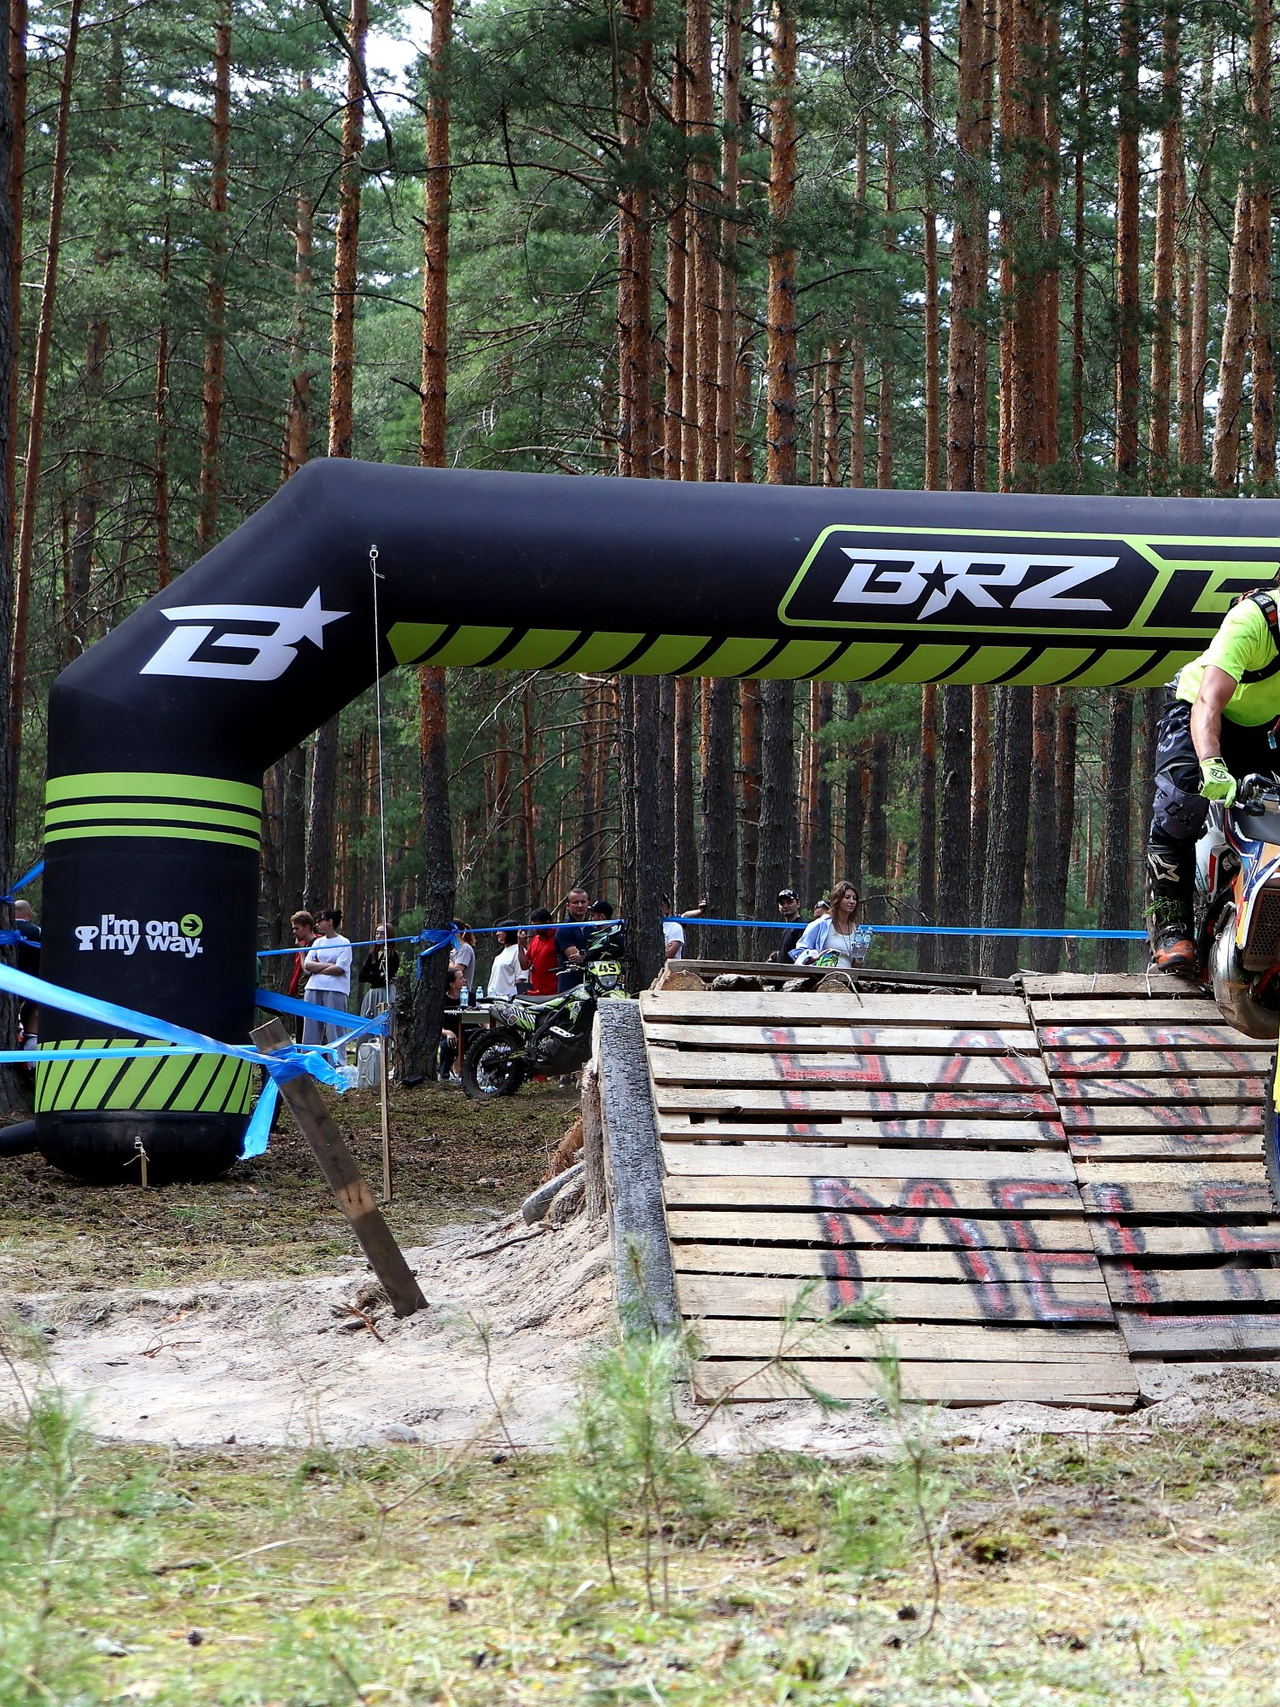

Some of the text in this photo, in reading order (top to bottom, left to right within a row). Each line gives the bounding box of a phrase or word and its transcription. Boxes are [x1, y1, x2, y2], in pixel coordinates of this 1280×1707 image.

[832, 547, 1120, 620] BRZ
[101, 914, 179, 937] I'm on
[100, 934, 203, 958] my way.
[599, 963, 617, 973] 45
